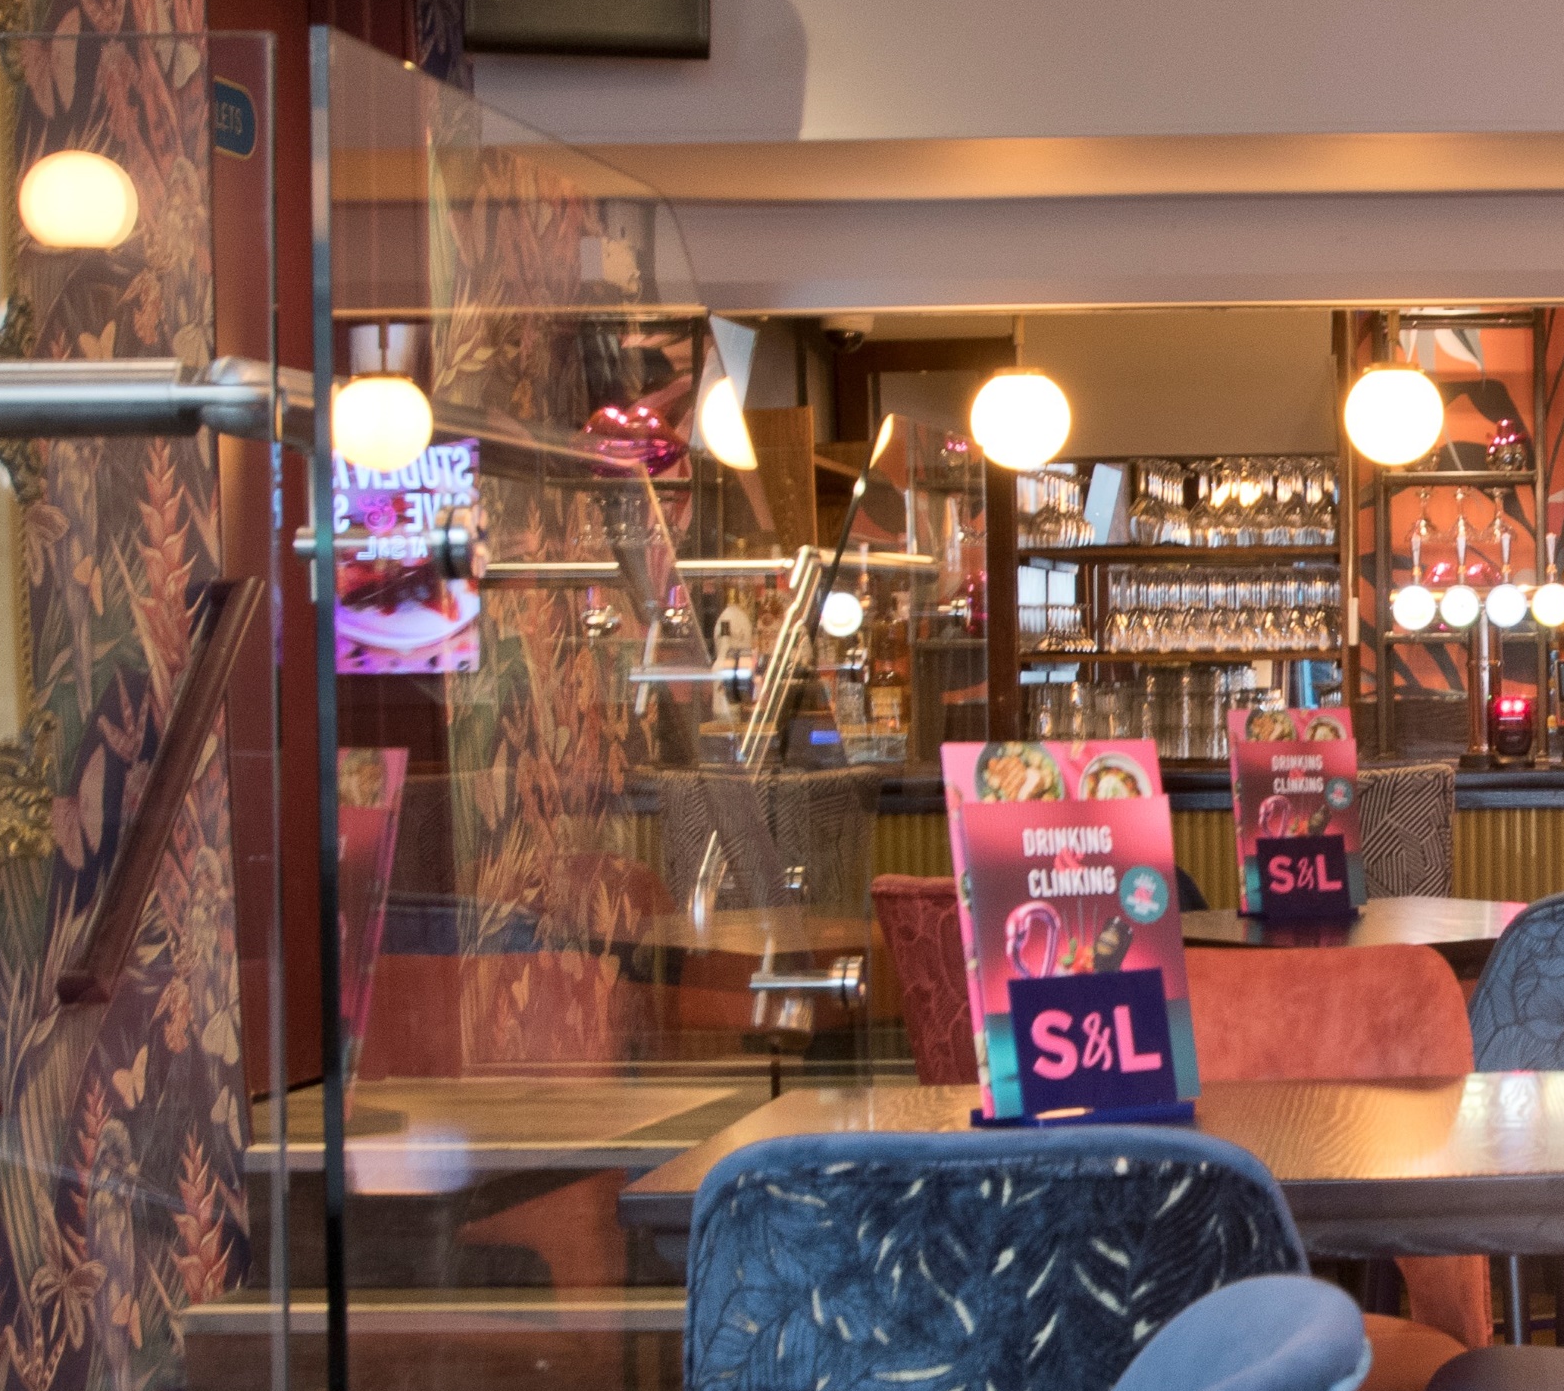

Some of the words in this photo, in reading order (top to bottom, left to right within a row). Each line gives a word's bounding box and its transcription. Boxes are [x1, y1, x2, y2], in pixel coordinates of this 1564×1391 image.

[1271, 754, 1323, 772] DRINKING
[1273, 777, 1324, 794] CLINKING
[1022, 825, 1112, 857] DRINKING
[1028, 866, 1117, 898] CLINKING
[1268, 854, 1343, 894] S&L
[1030, 1005, 1162, 1080] S&L
